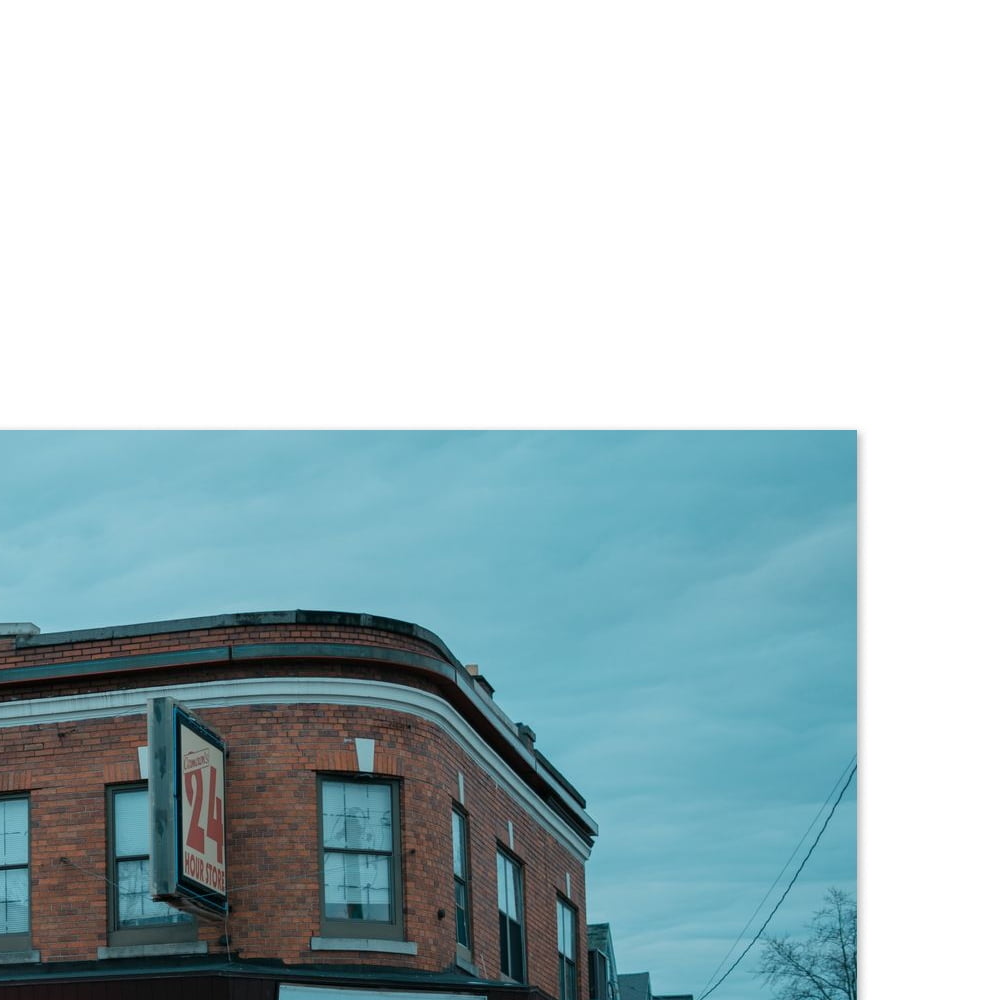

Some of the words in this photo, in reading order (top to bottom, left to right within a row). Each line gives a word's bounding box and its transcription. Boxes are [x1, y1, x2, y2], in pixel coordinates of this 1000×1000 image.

[184, 765, 224, 865] 24
[185, 851, 205, 882] HOUR
[205, 862, 225, 891] STORE
